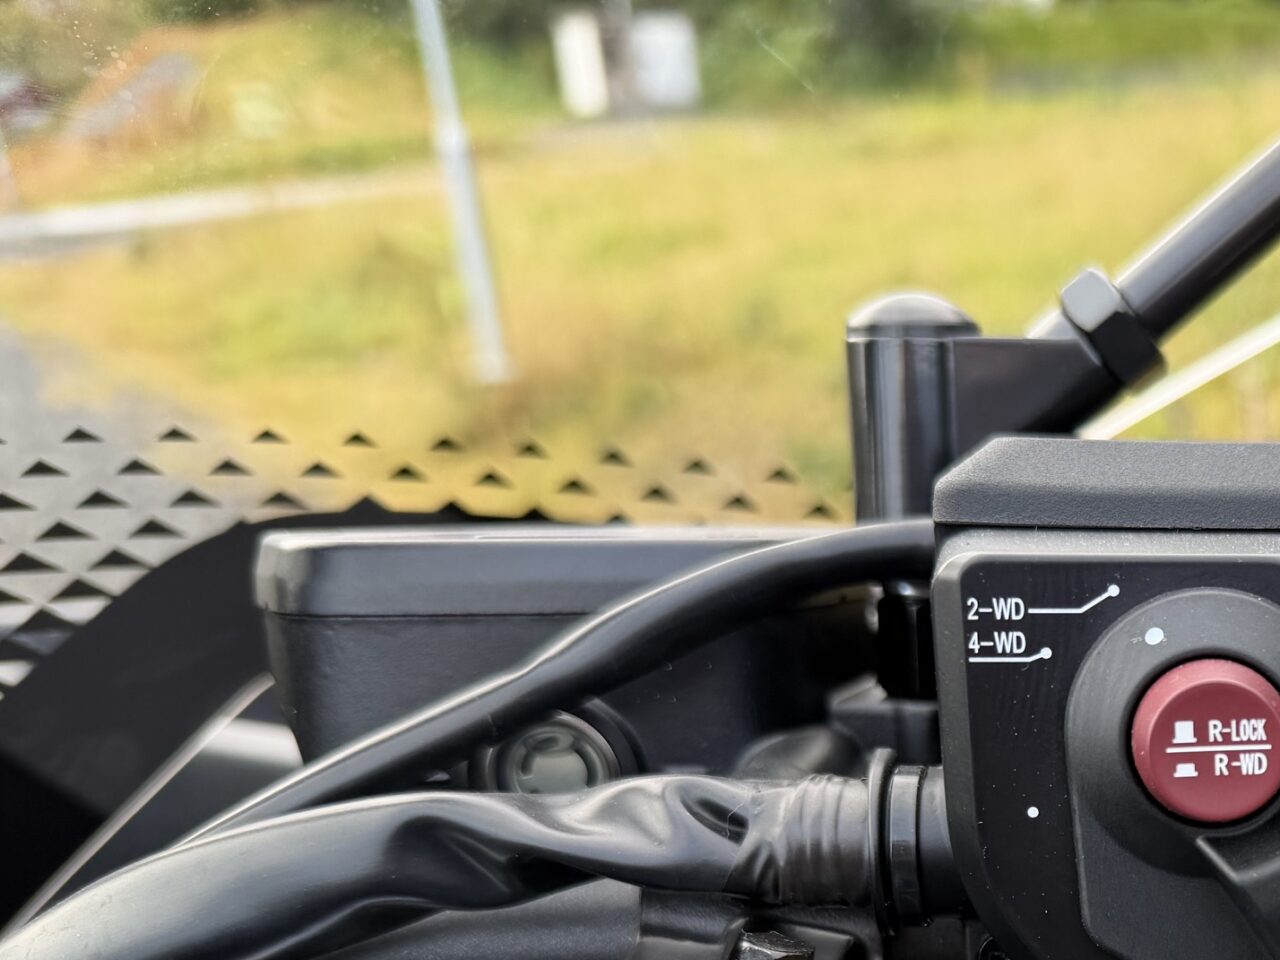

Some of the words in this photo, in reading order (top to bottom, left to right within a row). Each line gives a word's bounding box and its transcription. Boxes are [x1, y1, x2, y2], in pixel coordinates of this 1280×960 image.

[967, 597, 1025, 621] 2-WD
[968, 631, 1027, 654] 4-WD
[1208, 718, 1268, 743] R-LOCK
[1214, 752, 1268, 776] R-WD
